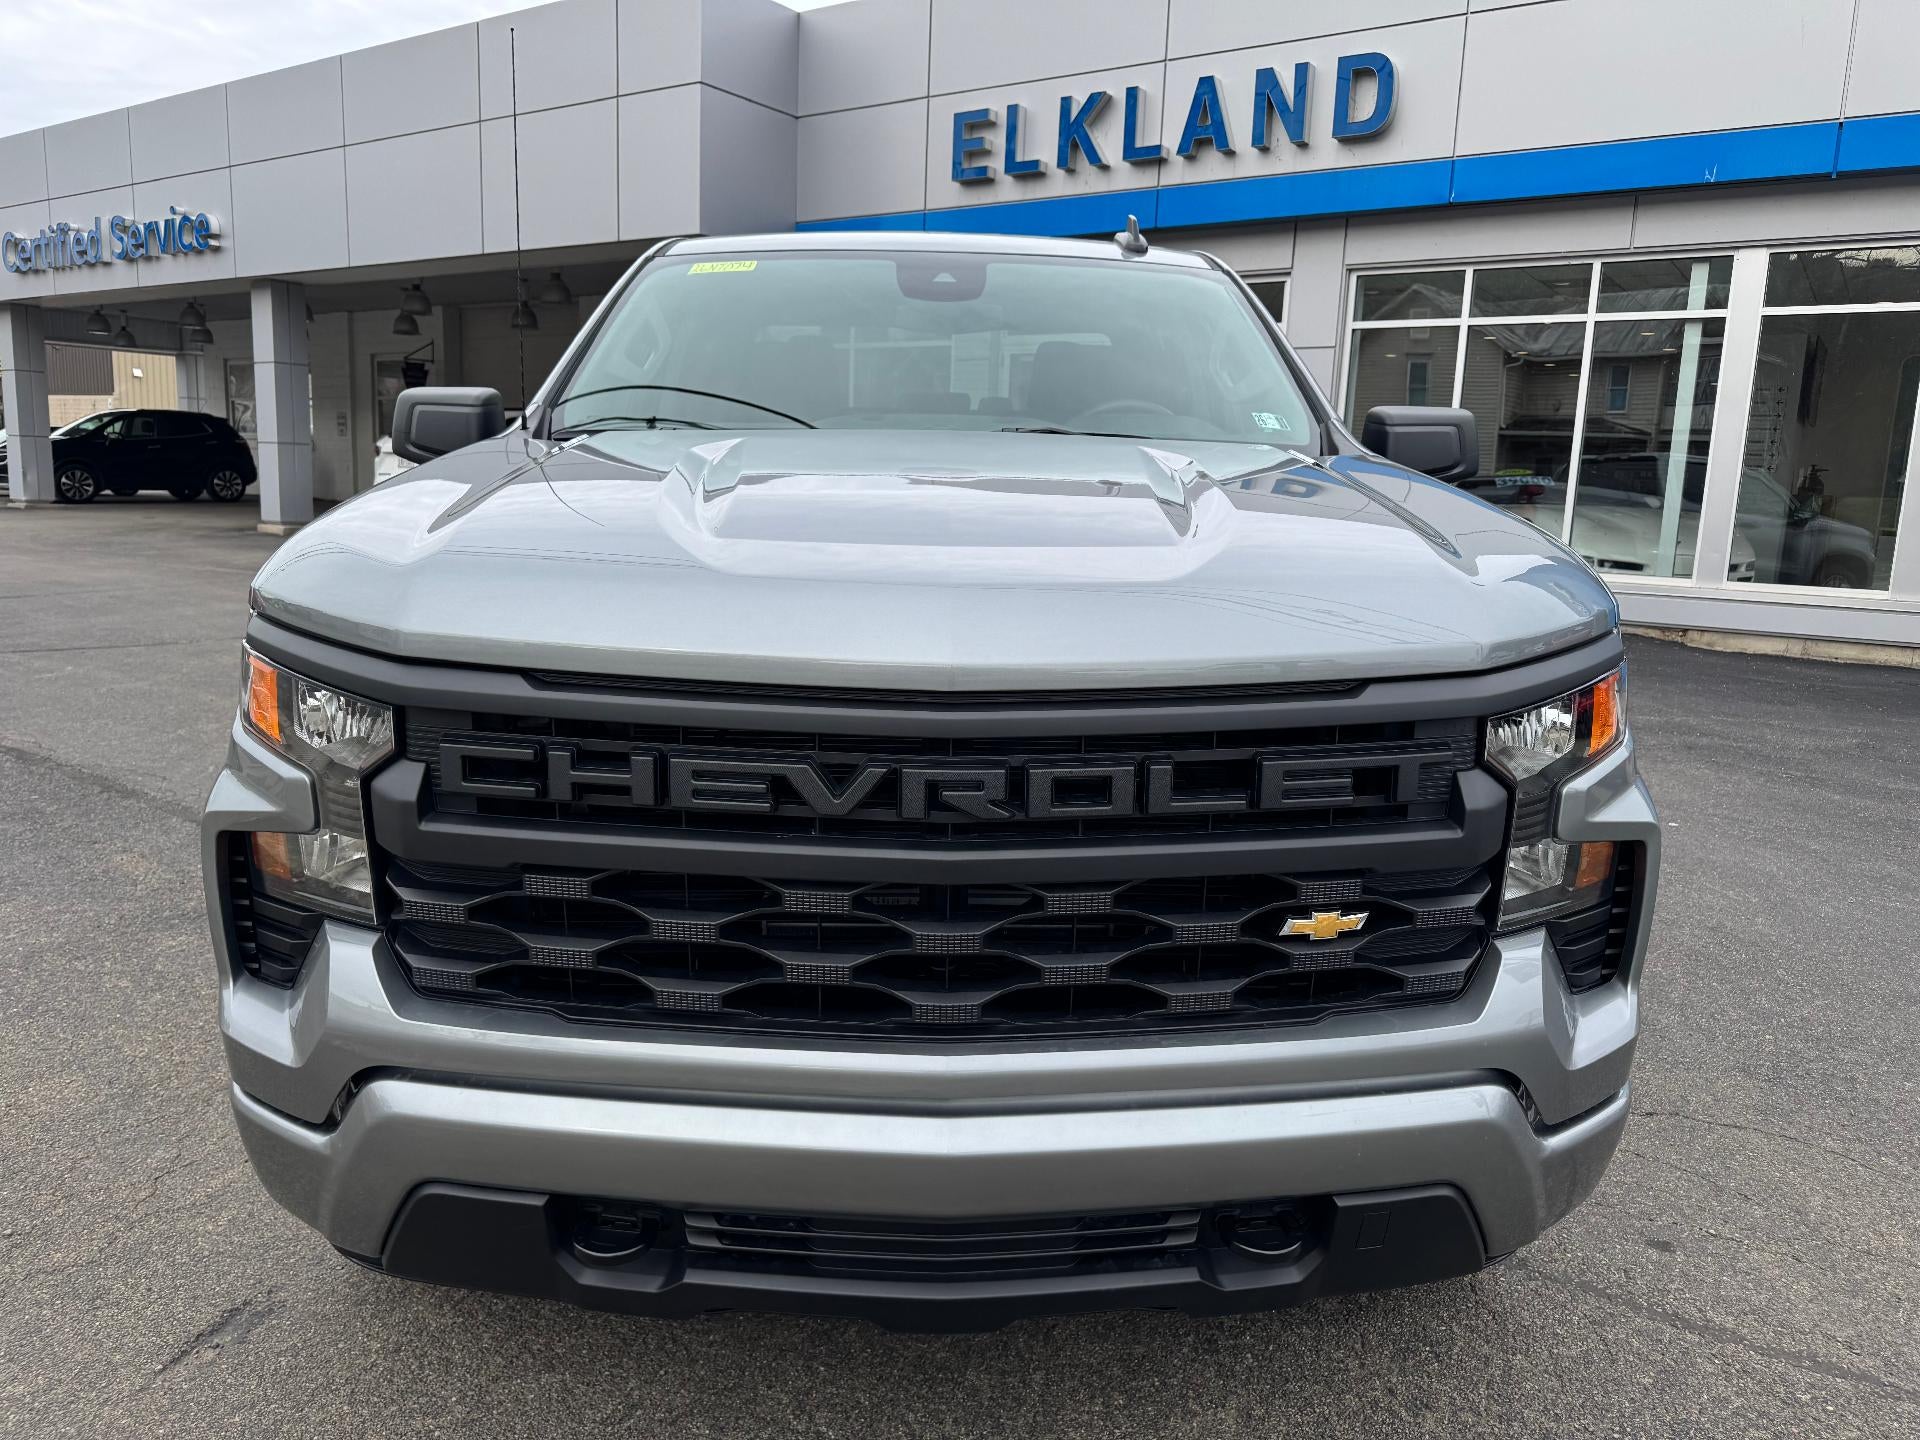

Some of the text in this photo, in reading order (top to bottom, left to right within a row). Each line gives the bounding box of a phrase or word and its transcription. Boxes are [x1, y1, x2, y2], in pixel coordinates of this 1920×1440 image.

[951, 51, 1400, 185] ELKLAND
[2, 205, 218, 274] Certified Service
[438, 742, 1455, 821] CHEVROLET
